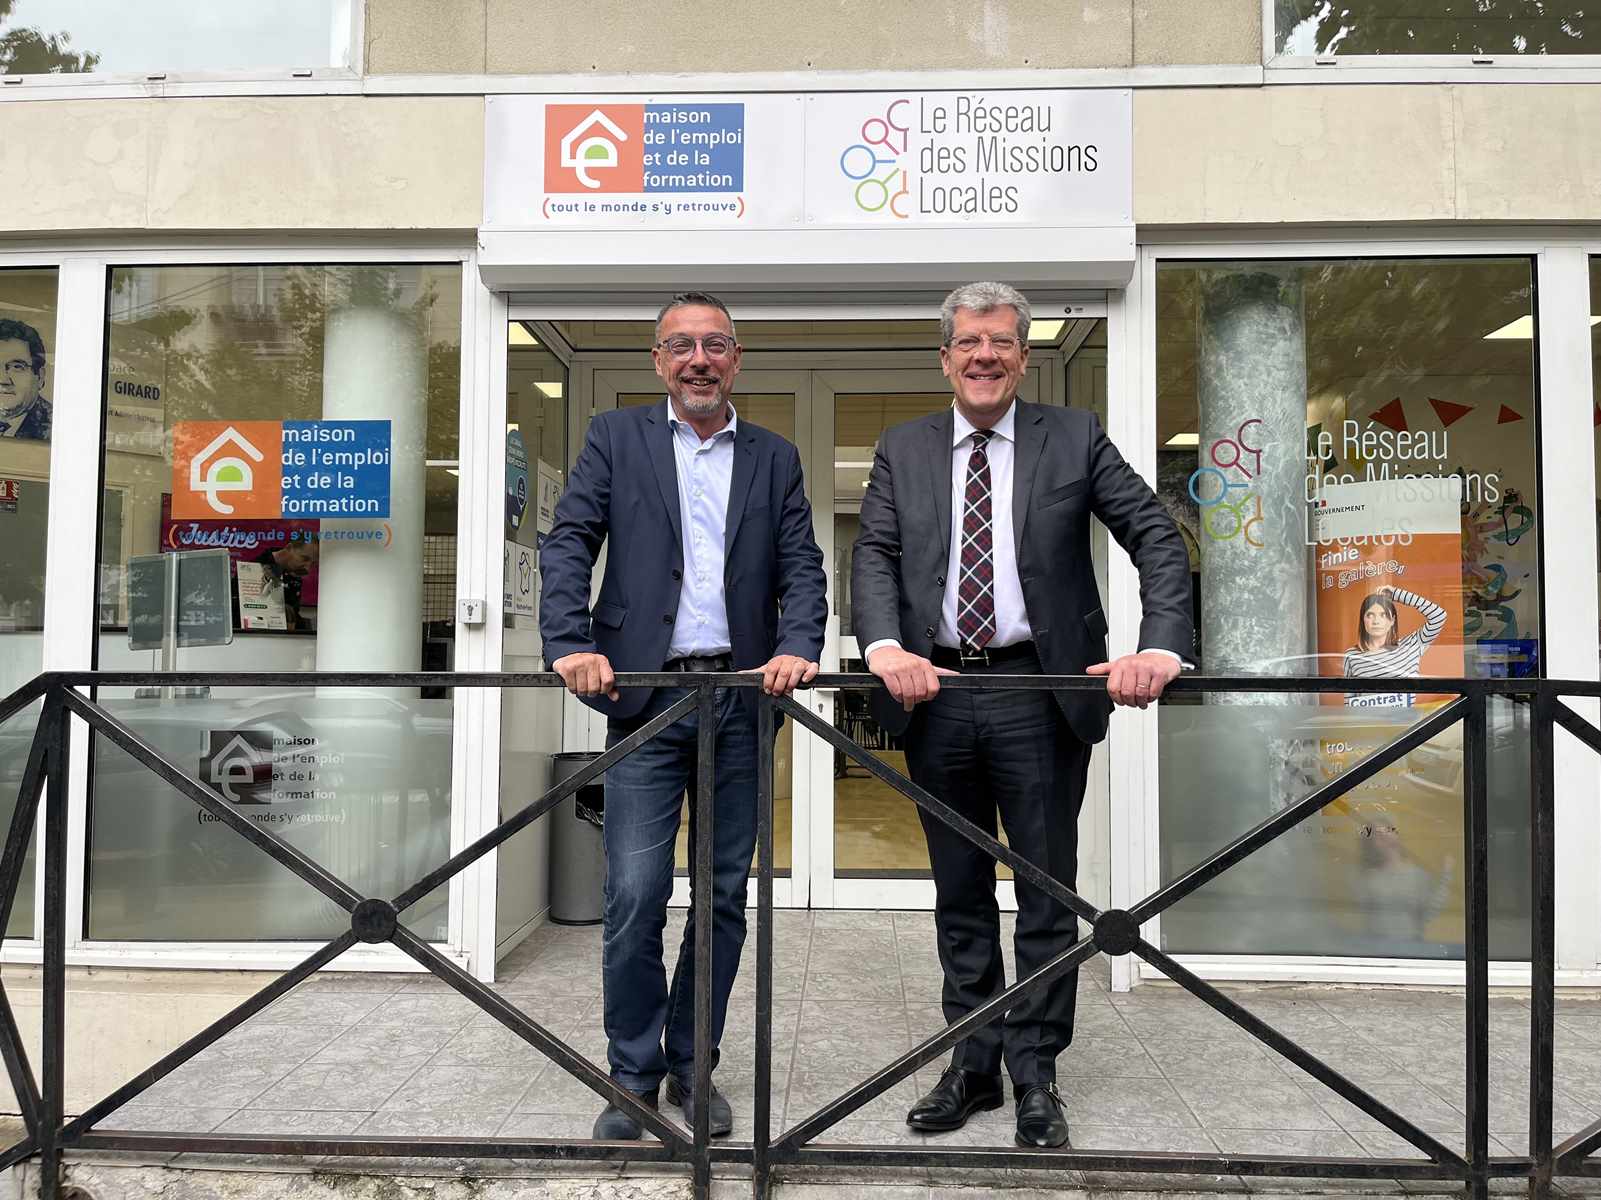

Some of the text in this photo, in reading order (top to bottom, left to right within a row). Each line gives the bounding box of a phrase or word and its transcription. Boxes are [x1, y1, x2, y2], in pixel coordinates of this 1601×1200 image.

[643, 108, 711, 123] maison
[920, 96, 1051, 134] Le Réseau
[643, 128, 742, 149] de l'emploi
[643, 150, 710, 165] et de la
[920, 135, 1098, 174] des Missions
[643, 171, 733, 186] formation
[920, 176, 1018, 214] Locales
[543, 196, 745, 219] (tout le monde s'y retrouve)
[114, 380, 161, 400] GIRARD
[281, 425, 356, 442] maison
[1304, 419, 1449, 460] Le Réseau
[281, 447, 390, 470] de l'emploi
[281, 471, 354, 489] et de la
[281, 496, 379, 513] formation
[1314, 504, 1365, 517] GOUVERNEMENT
[290, 529, 312, 544] s'y
[1350, 692, 1403, 708] Contrat
[273, 735, 319, 746] maison
[273, 753, 288, 764] de
[272, 772, 285, 781] et
[288, 771, 304, 782] de
[272, 788, 336, 800] formation
